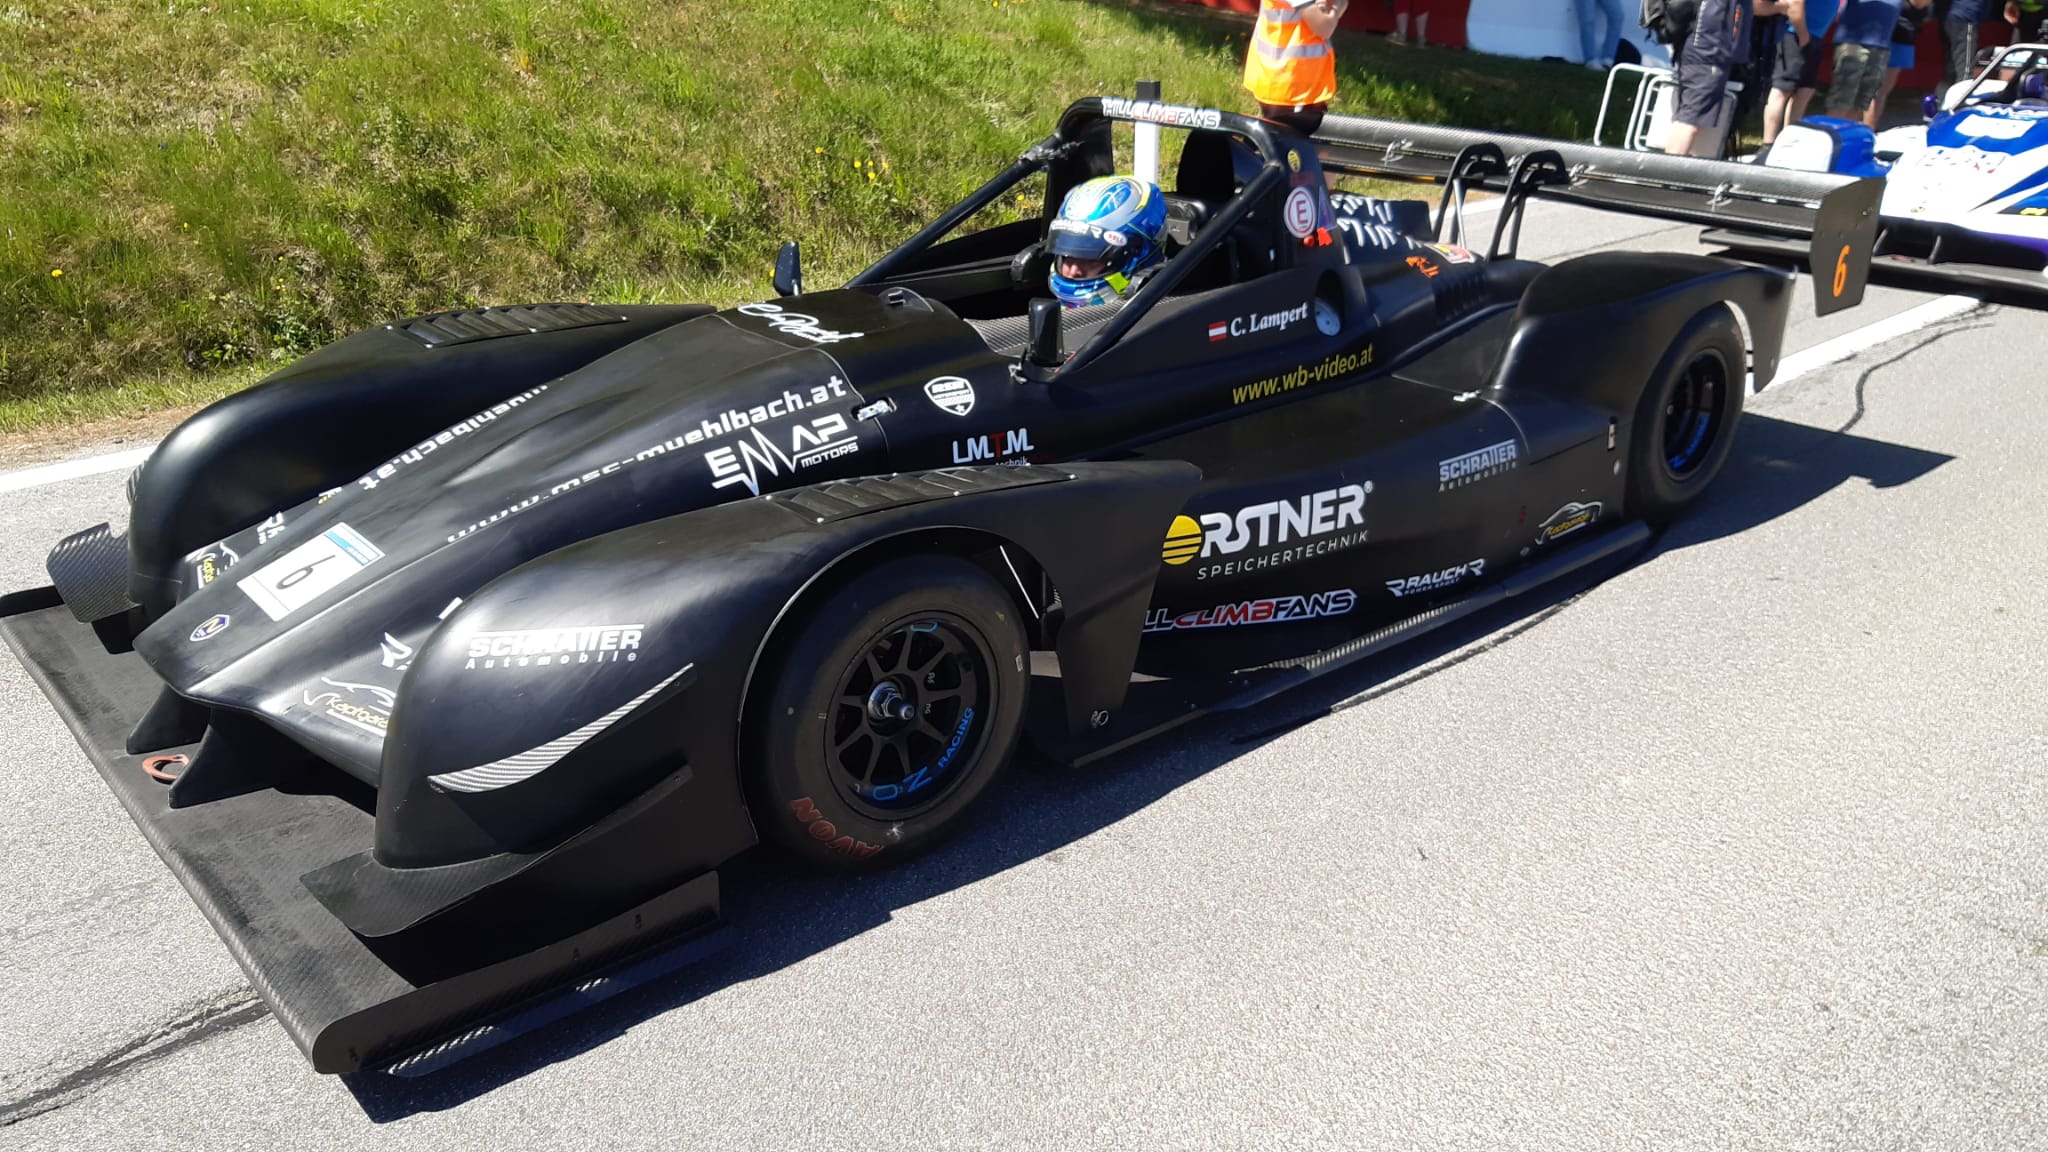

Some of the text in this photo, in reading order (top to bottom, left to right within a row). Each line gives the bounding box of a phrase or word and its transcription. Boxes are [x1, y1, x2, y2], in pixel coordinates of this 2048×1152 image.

[1833, 245, 1850, 297] 6
[1230, 302, 1309, 337] C. Lampert
[1232, 343, 1374, 405] www.wb-video.at
[447, 374, 848, 543] www.msc-muehlbach.at
[801, 441, 859, 468] MOTORS
[1438, 461, 1518, 493] Automobile
[1439, 438, 1517, 482] SCHRATTER
[275, 554, 336, 590] 6
[1197, 529, 1369, 581] SPEICHERTECHNIK
[464, 650, 637, 670] Automobile
[937, 706, 975, 769] RACING
[792, 796, 883, 858] AVON
